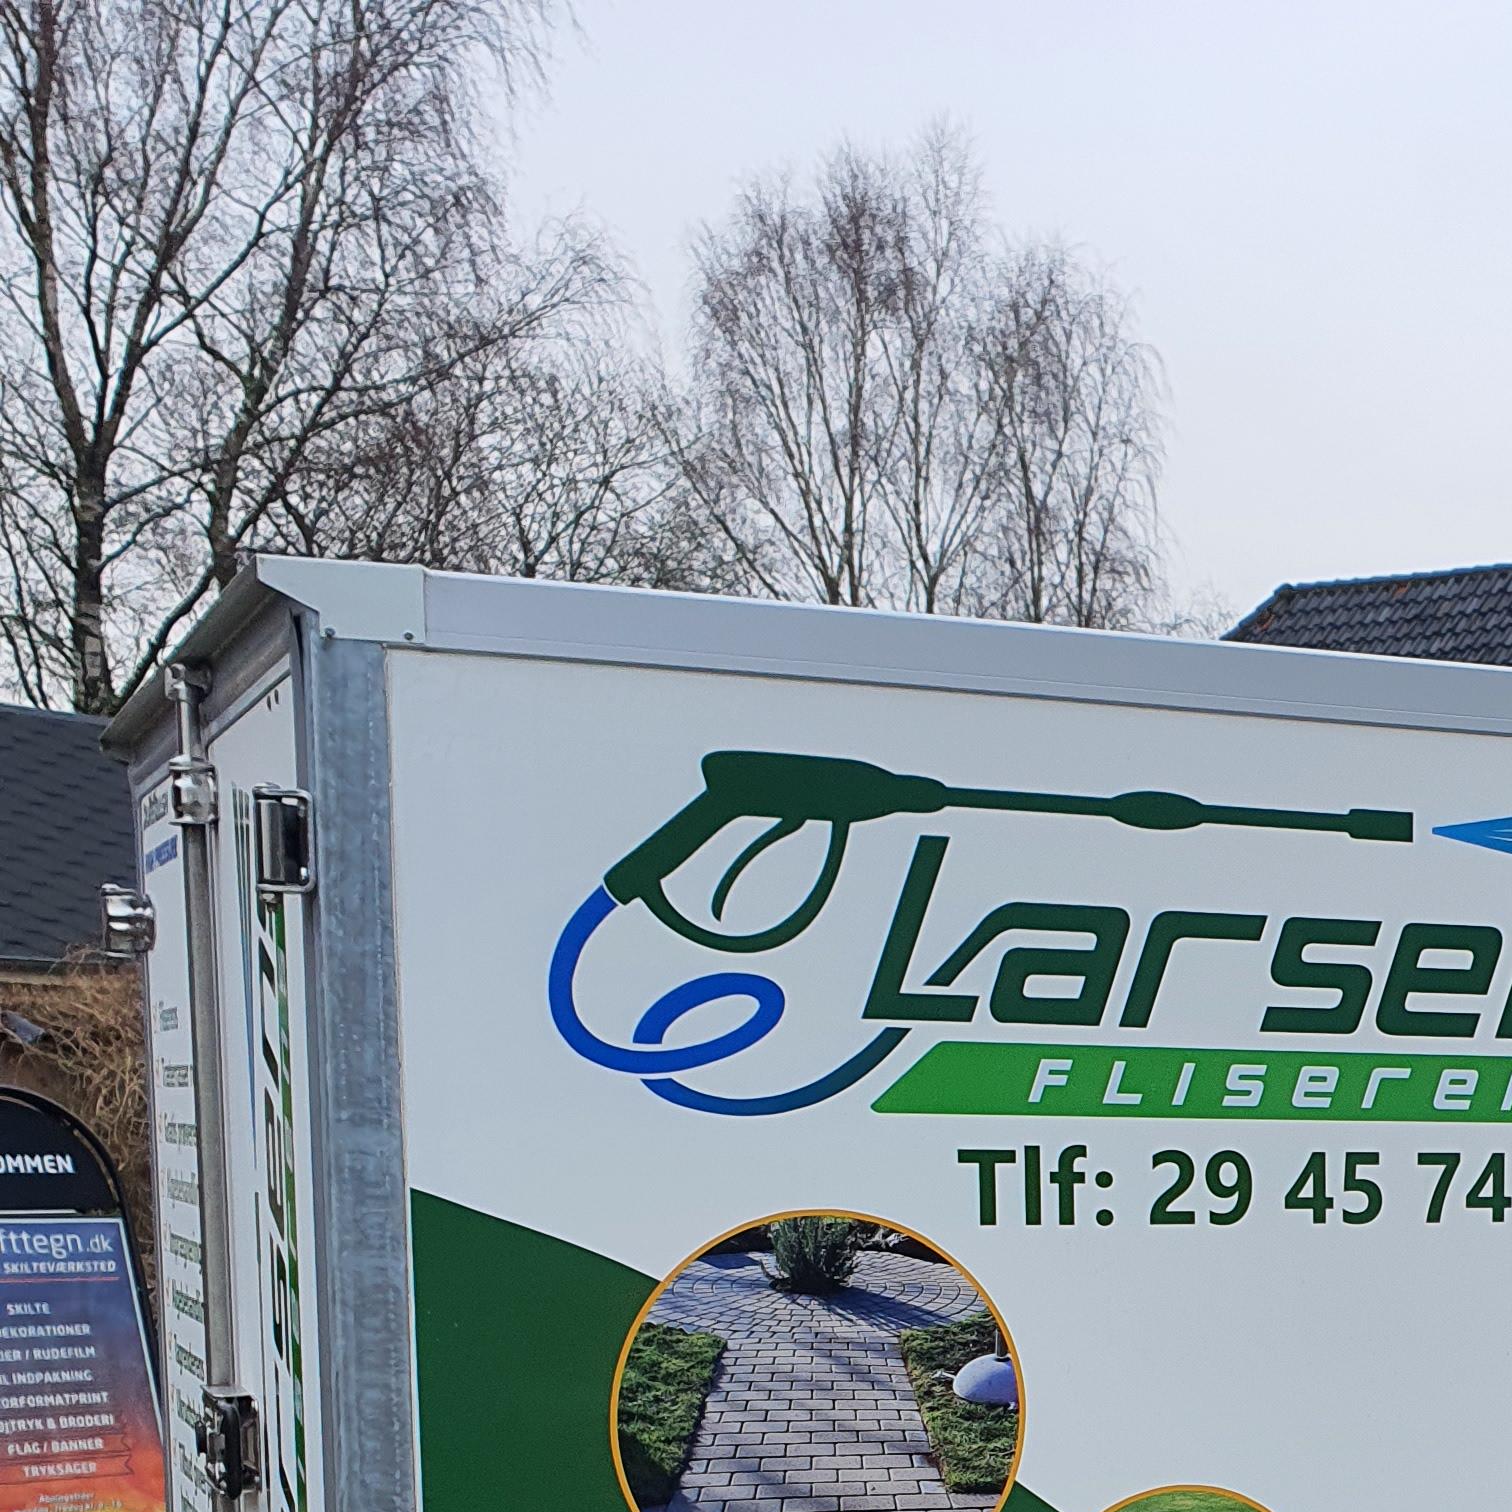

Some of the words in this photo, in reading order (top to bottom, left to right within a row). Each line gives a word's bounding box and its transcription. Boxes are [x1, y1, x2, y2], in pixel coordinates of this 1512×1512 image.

[957, 1144, 1114, 1227] Tlf:
[1149, 1149, 1253, 1226] 29
[1284, 1151, 1383, 1225] 45
[1417, 1152, 1512, 1224] 74
[3, 1260, 116, 1275] SKILTEVÆRKSTED
[6, 1302, 51, 1316] SKILTE
[0, 1323, 91, 1339] EKORATIONER
[33, 1346, 96, 1361] RUDEFILM
[12, 1369, 94, 1385] INDPAKNING
[58, 1413, 115, 1430] BRODERI
[7, 1440, 40, 1456] FLAG
[51, 1438, 104, 1454] BANNER
[23, 1462, 97, 1478] TRYKSAGER
